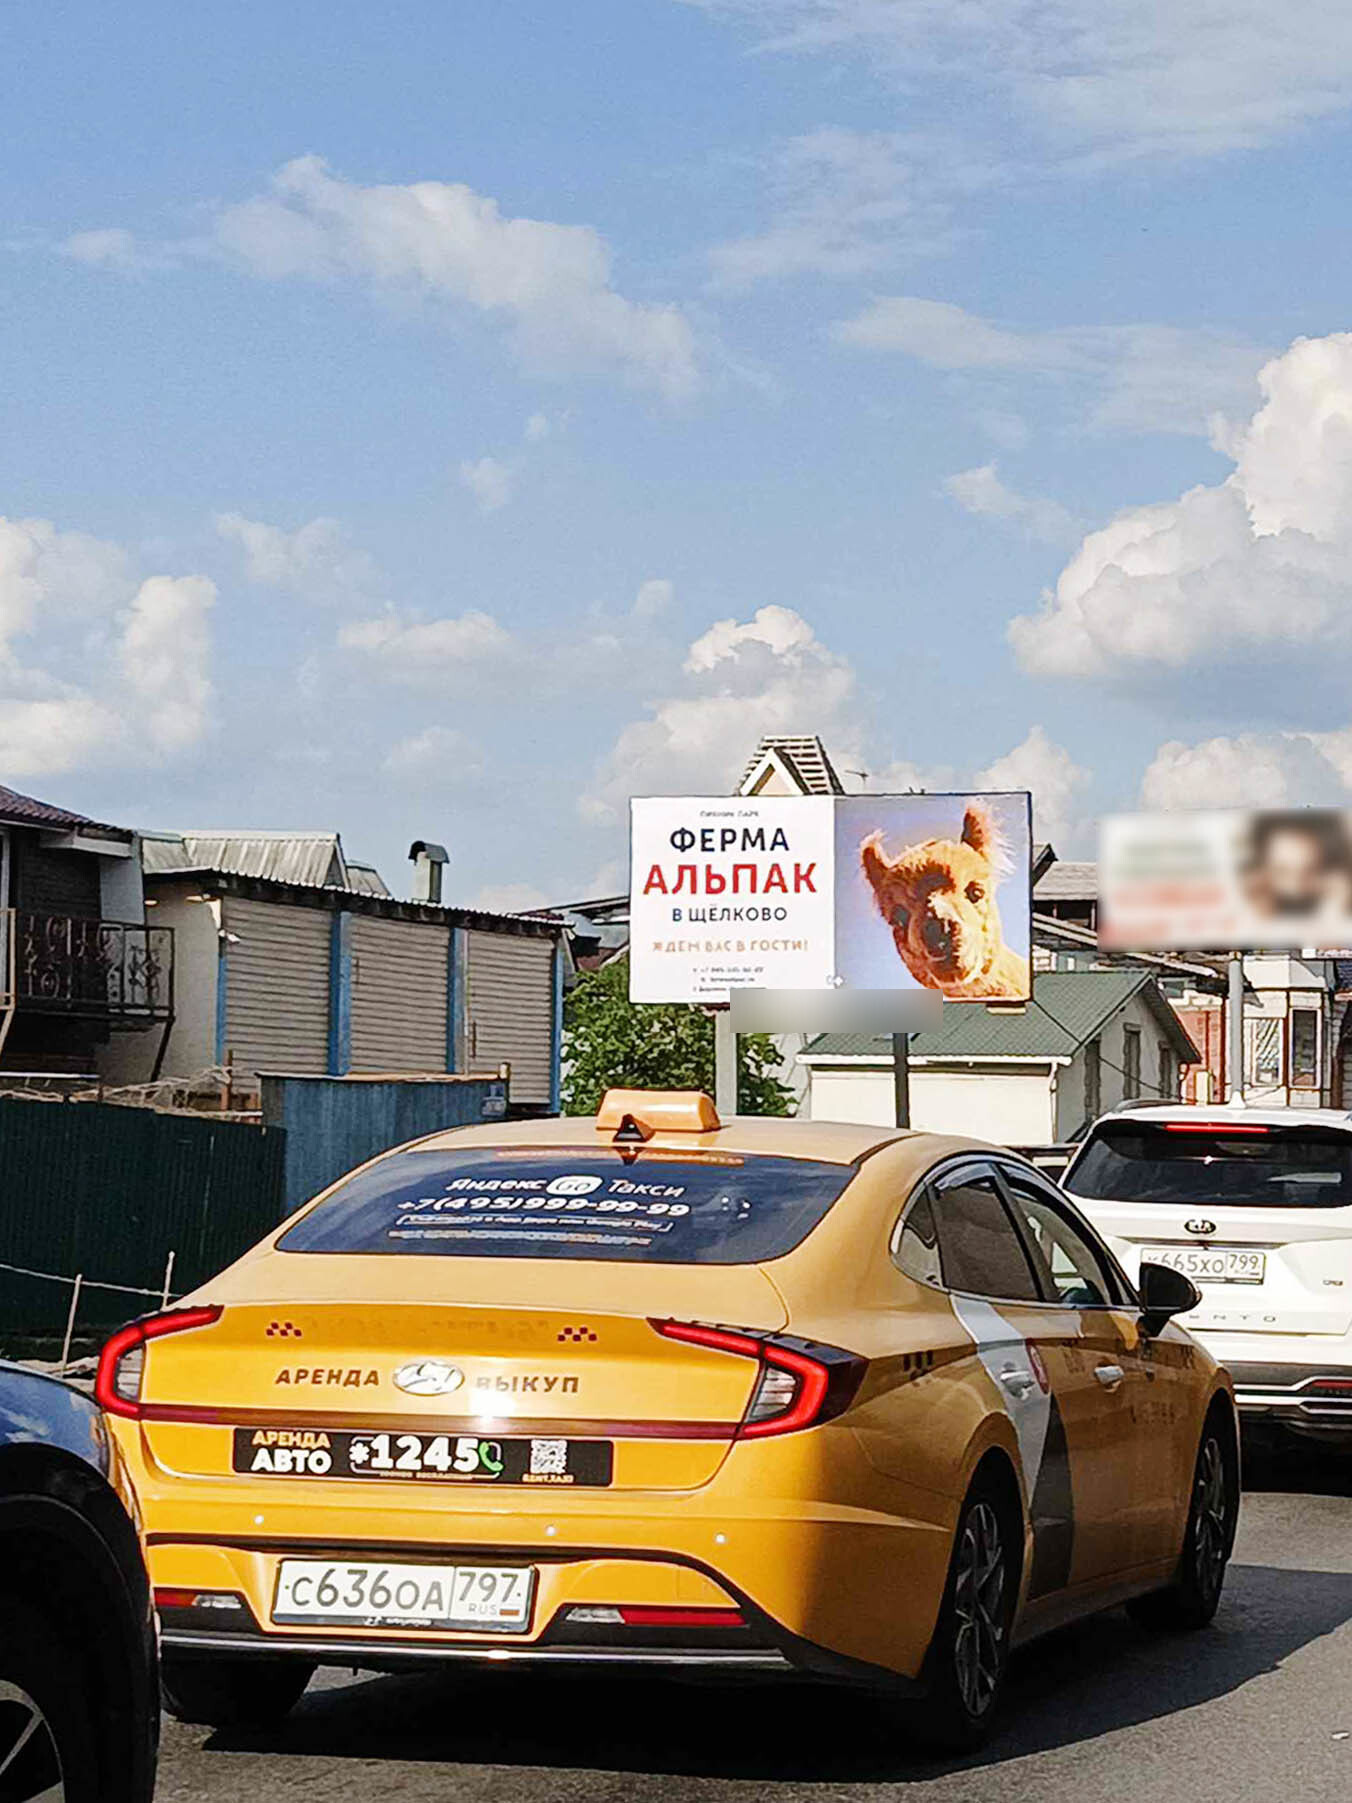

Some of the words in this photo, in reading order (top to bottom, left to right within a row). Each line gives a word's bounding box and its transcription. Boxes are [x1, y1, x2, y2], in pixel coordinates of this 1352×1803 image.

[670, 827, 790, 852] ФЕРМА
[643, 863, 817, 895] АЛЬПАК
[672, 908, 683, 922] В
[688, 904, 788, 923] ЩЁЛКОВО
[705, 941, 731, 952] ВАС
[736, 940, 746, 952] В
[750, 939, 808, 952] ГОСТИ!
[446, 1177, 548, 1192] Яндекс
[608, 1179, 686, 1198] Такси
[1230, 1254, 1259, 1270] 799
[275, 1368, 380, 1387] АРЕНДА
[476, 1375, 580, 1394] ВЫКУП
[252, 1430, 332, 1449] АРЕНДА
[251, 1448, 333, 1474] АВТО
[291, 1568, 444, 1612] С636ОА
[458, 1571, 519, 1602] 797
[468, 1603, 498, 1616] RUS
